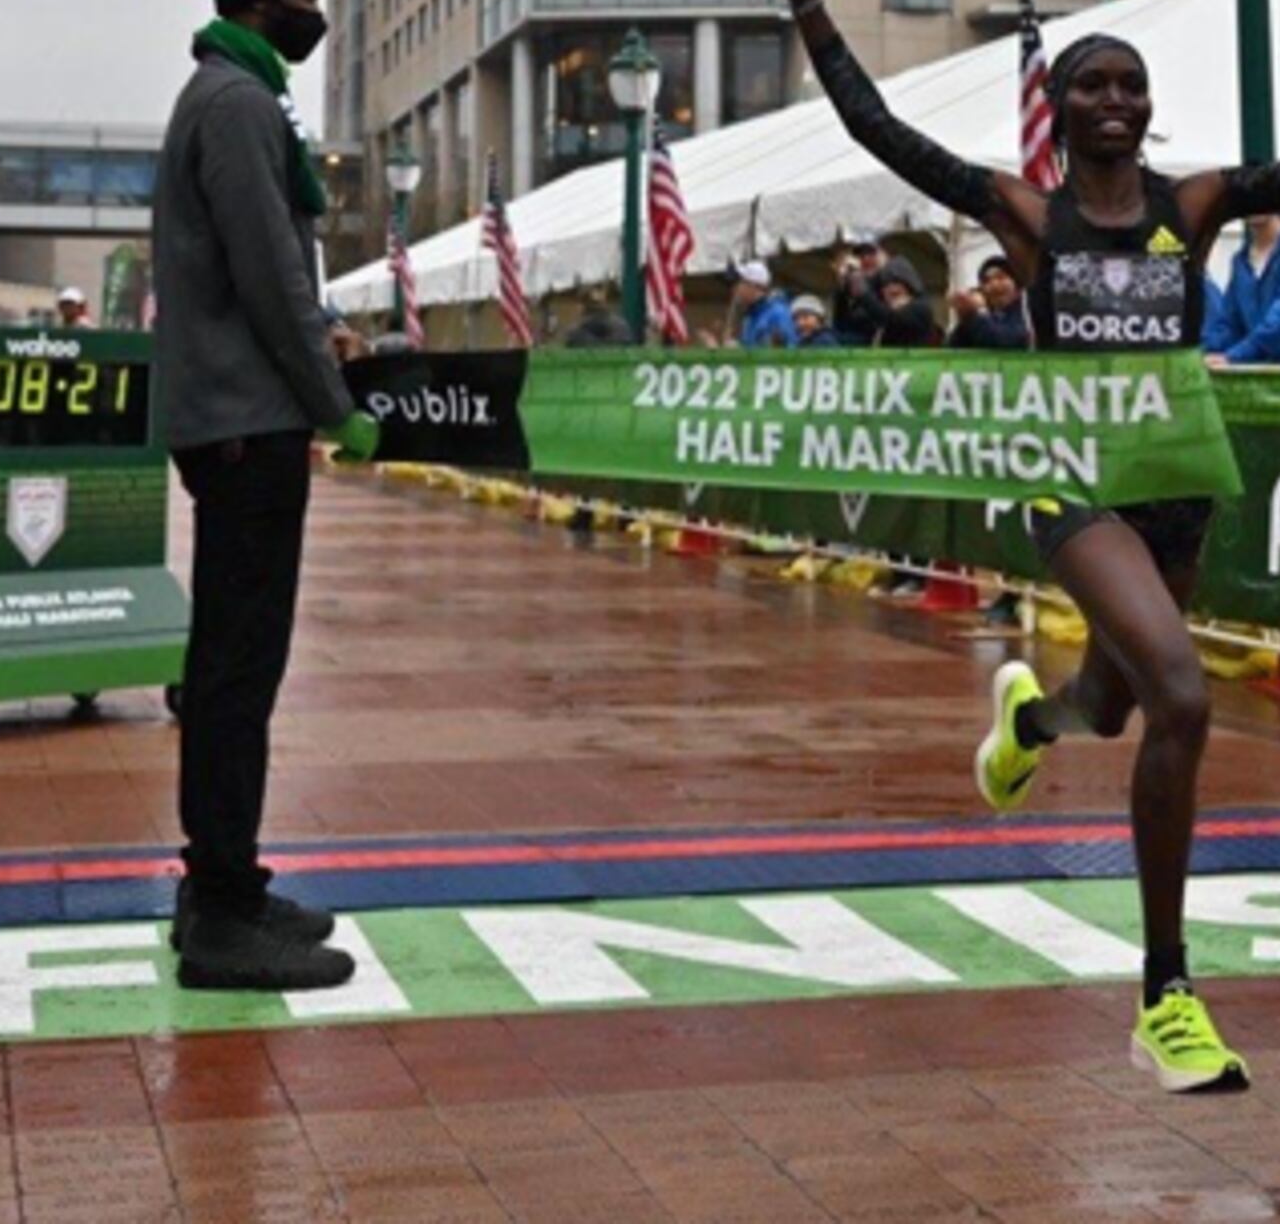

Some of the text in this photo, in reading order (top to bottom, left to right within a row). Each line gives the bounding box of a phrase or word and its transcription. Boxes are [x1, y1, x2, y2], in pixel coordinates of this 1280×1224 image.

[6, 331, 81, 358] wahoo
[1056, 312, 1182, 342] DORCAS
[366, 384, 490, 425] Publix
[632, 363, 1172, 424] 2022 PUBLIX ATLANTA
[675, 418, 1098, 486] HALF MARATHON
